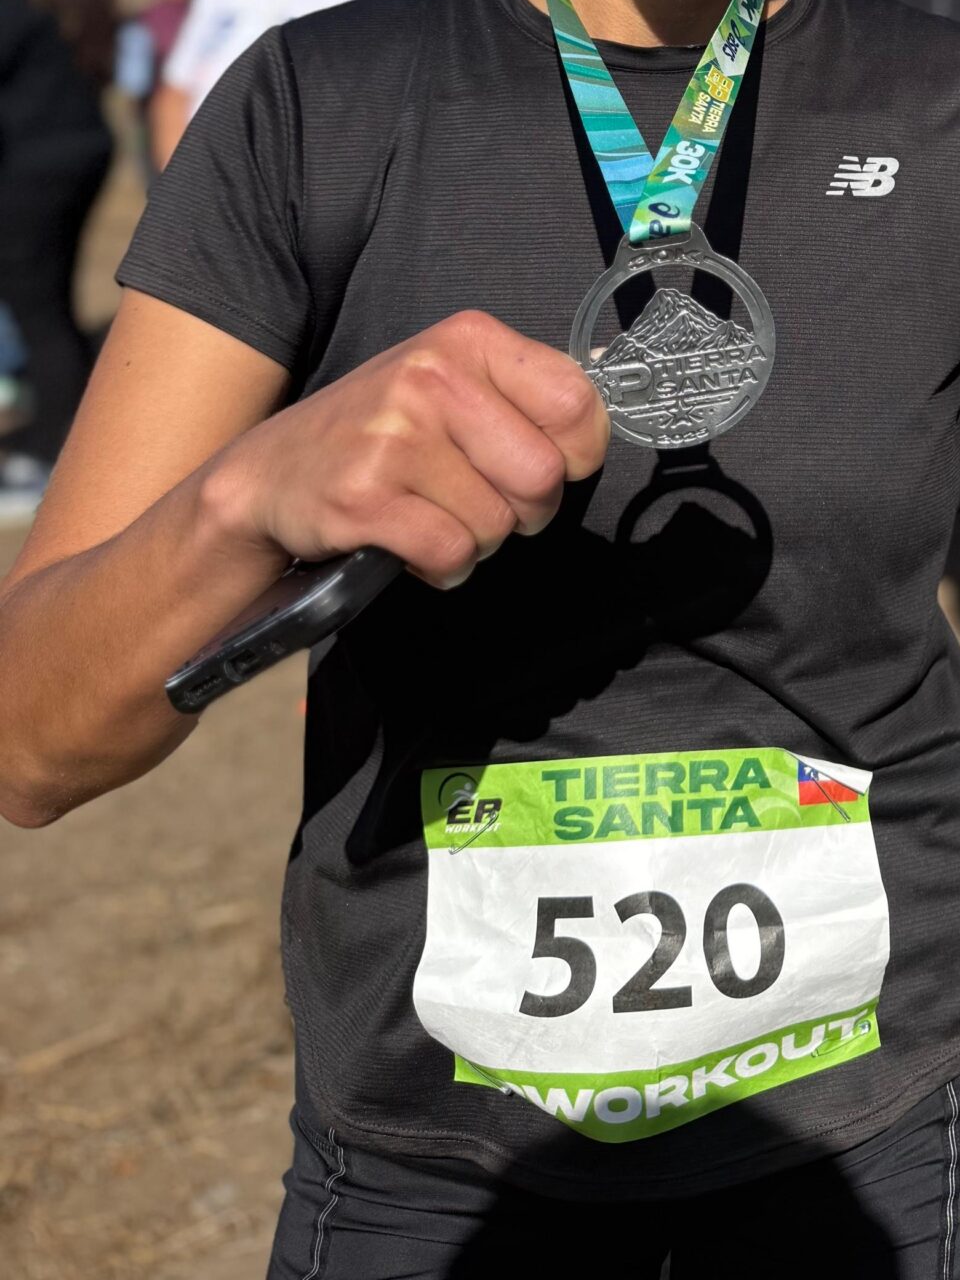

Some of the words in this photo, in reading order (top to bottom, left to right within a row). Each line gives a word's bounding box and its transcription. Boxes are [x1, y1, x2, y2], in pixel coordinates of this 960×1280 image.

[688, 91, 711, 124] SANTA
[702, 101, 725, 133] TIERRA
[662, 140, 705, 185] 30K
[653, 344, 767, 377] TIERRA
[656, 367, 759, 399] SANTA
[541, 756, 773, 803] TIERRA
[553, 796, 763, 841] SANTA
[518, 882, 786, 1018] 520
[504, 1008, 868, 1124] WORKOUT
